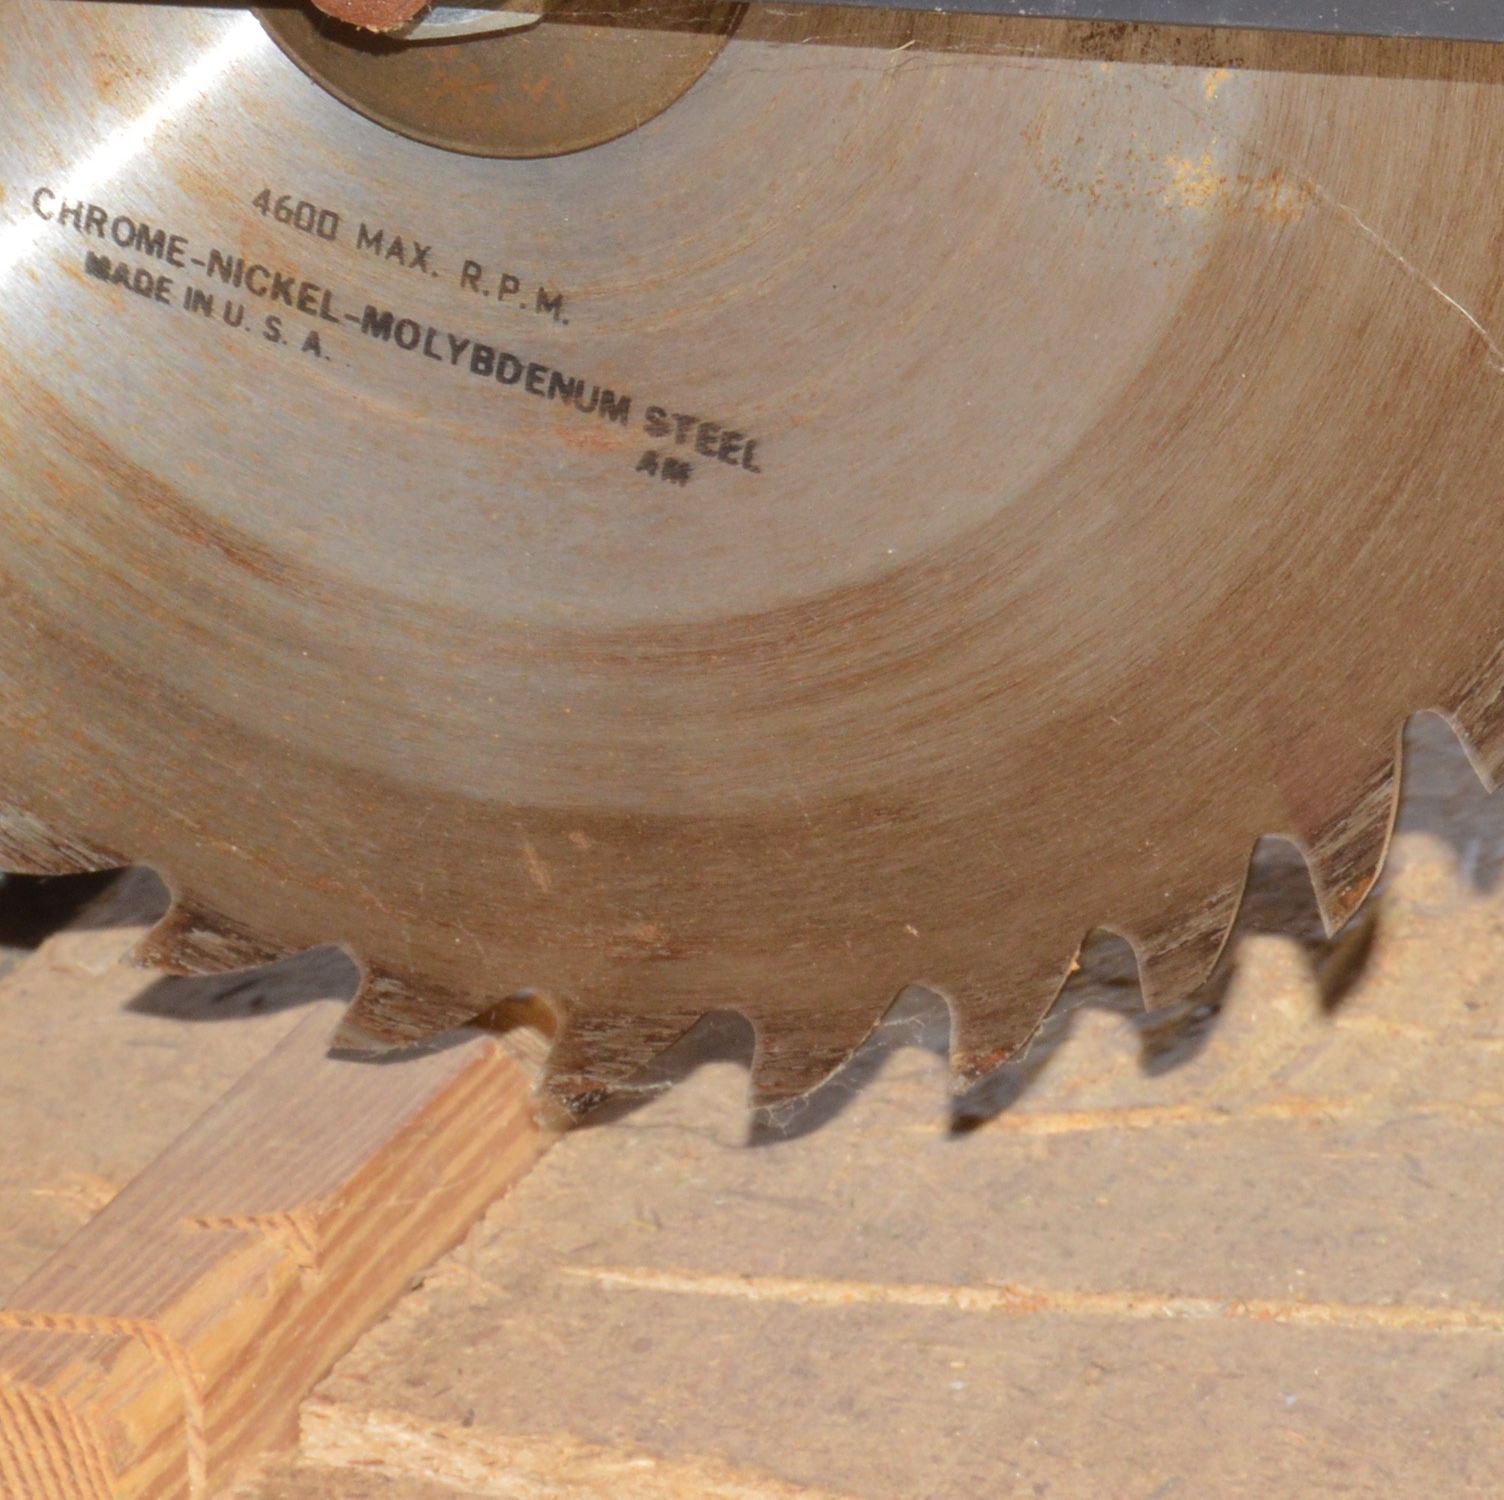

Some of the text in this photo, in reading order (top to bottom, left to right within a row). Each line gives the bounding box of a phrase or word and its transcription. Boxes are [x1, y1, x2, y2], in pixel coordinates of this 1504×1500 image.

[251, 188, 341, 242] 4600
[355, 223, 439, 278] MAX.
[84, 250, 174, 306] MADE
[183, 286, 214, 318] IN
[643, 405, 762, 474] STEEL
